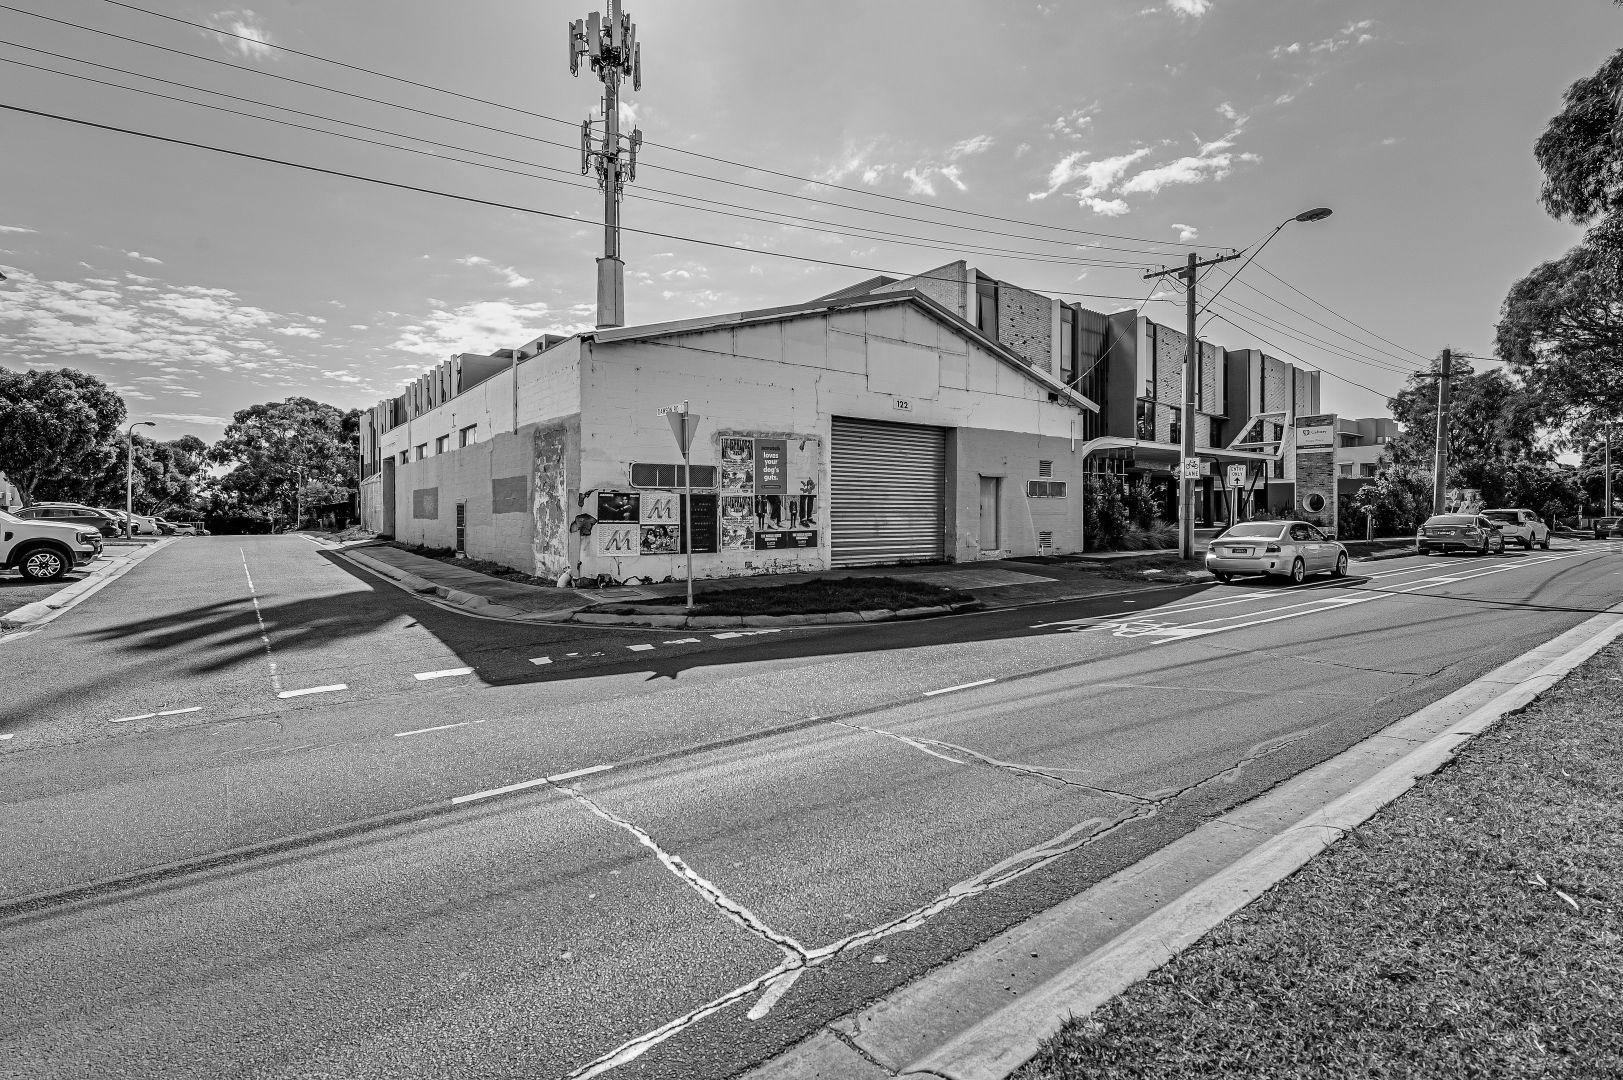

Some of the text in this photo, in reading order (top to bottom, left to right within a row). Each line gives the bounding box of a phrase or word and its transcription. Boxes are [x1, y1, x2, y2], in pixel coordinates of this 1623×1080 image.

[897, 400, 909, 409] 122
[763, 451, 779, 459] loves
[763, 466, 780, 474] dog's
[763, 474, 779, 482] guts.
